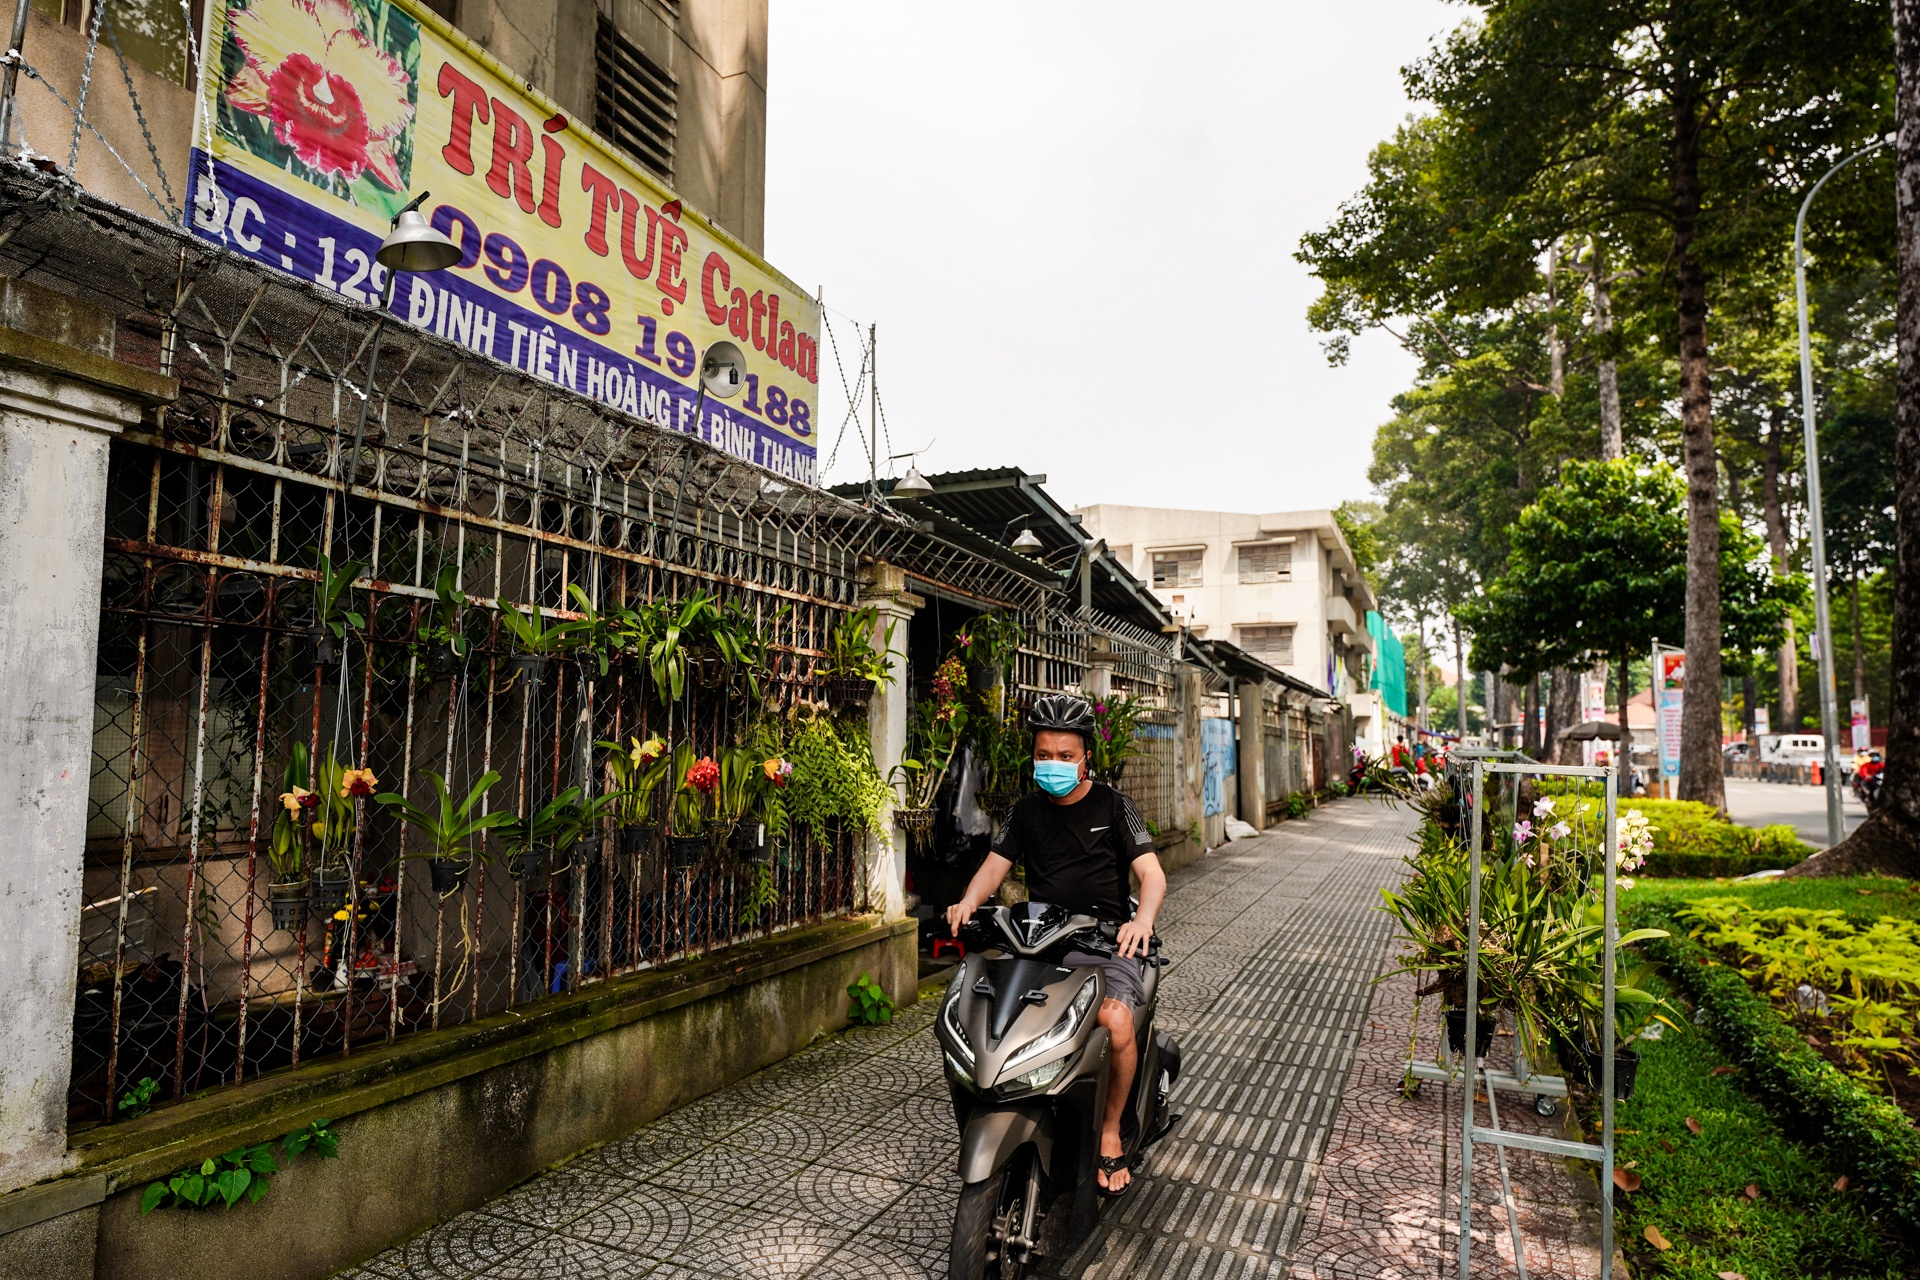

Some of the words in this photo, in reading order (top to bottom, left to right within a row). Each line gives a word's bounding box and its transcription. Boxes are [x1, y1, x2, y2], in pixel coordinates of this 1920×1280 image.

[430, 204, 611, 336] 0908
[635, 314, 706, 390] 19
[743, 373, 812, 437] 188
[438, 61, 568, 229] TRÍ
[581, 162, 688, 316] TUỆ
[701, 251, 818, 384] Catlan
[315, 236, 396, 310] 129
[408, 275, 497, 356] ĐINH
[508, 320, 578, 391] TIÊN
[587, 355, 672, 429] HOÀNG
[710, 408, 756, 465] BÌNH
